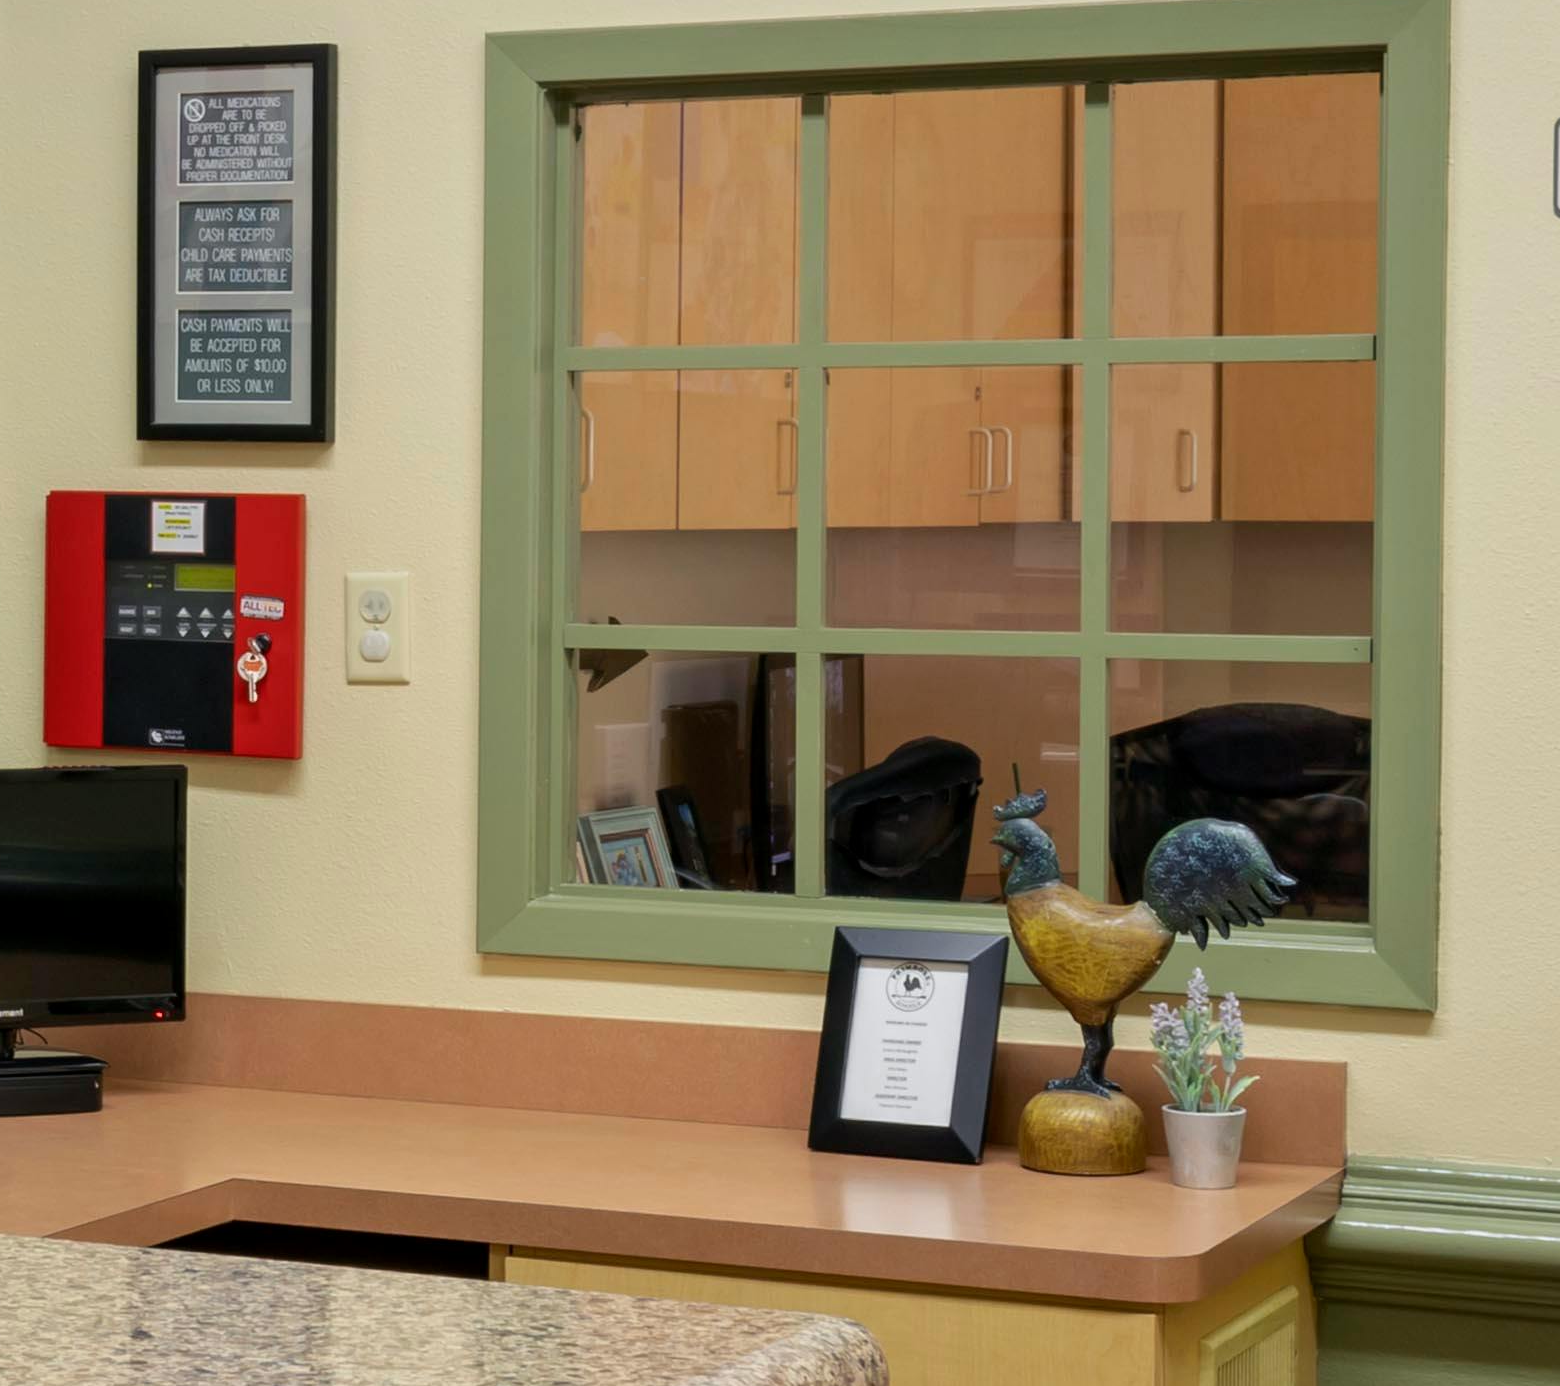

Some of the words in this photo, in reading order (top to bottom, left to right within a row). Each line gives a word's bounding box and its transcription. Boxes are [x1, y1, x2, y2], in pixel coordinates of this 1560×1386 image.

[209, 99, 223, 109] ALL
[227, 97, 281, 108] MEDICATIONS
[222, 110, 237, 120] ARE
[242, 110, 252, 120] TO
[255, 109, 266, 120] BE
[189, 122, 226, 133] DROPPED
[229, 122, 245, 132] OFF
[258, 121, 286, 131] PICKED
[187, 135, 199, 145] UP
[201, 134, 212, 145] AT
[216, 134, 231, 145] THE
[234, 134, 260, 144] FRONT
[194, 147, 206, 157] NO
[209, 146, 256, 157] MEDICATION
[259, 146, 279, 156] WILL
[182, 159, 192, 170] BE
[196, 158, 254, 169] ADMINISTERED
[257, 157, 292, 168] WITHOUT
[186, 171, 218, 181] PROPER
[194, 207, 233, 222] ALWAYS
[237, 207, 256, 221] ASK
[260, 207, 280, 221] FOR
[198, 228, 224, 242] CASH
[181, 248, 208, 262] CHILD
[212, 248, 236, 262] CARE
[241, 248, 293, 262] PAYMENTS
[185, 268, 203, 282] ARE
[208, 268, 226, 282] TAX
[230, 268, 287, 282] DEDUCTIBLE
[181, 318, 206, 332] CASH
[211, 318, 263, 332] PAYMENTS
[266, 318, 291, 332] WILL
[190, 338, 203, 352] BE
[207, 338, 256, 352] ACCEPTED
[261, 338, 281, 352] FOR
[185, 359, 232, 373] AMOUNTS
[236, 359, 248, 373] OF
[254, 359, 286, 373] $10.00
[197, 379, 211, 393] OR
[215, 379, 240, 393] LESS
[245, 379, 274, 393] ONLY!
